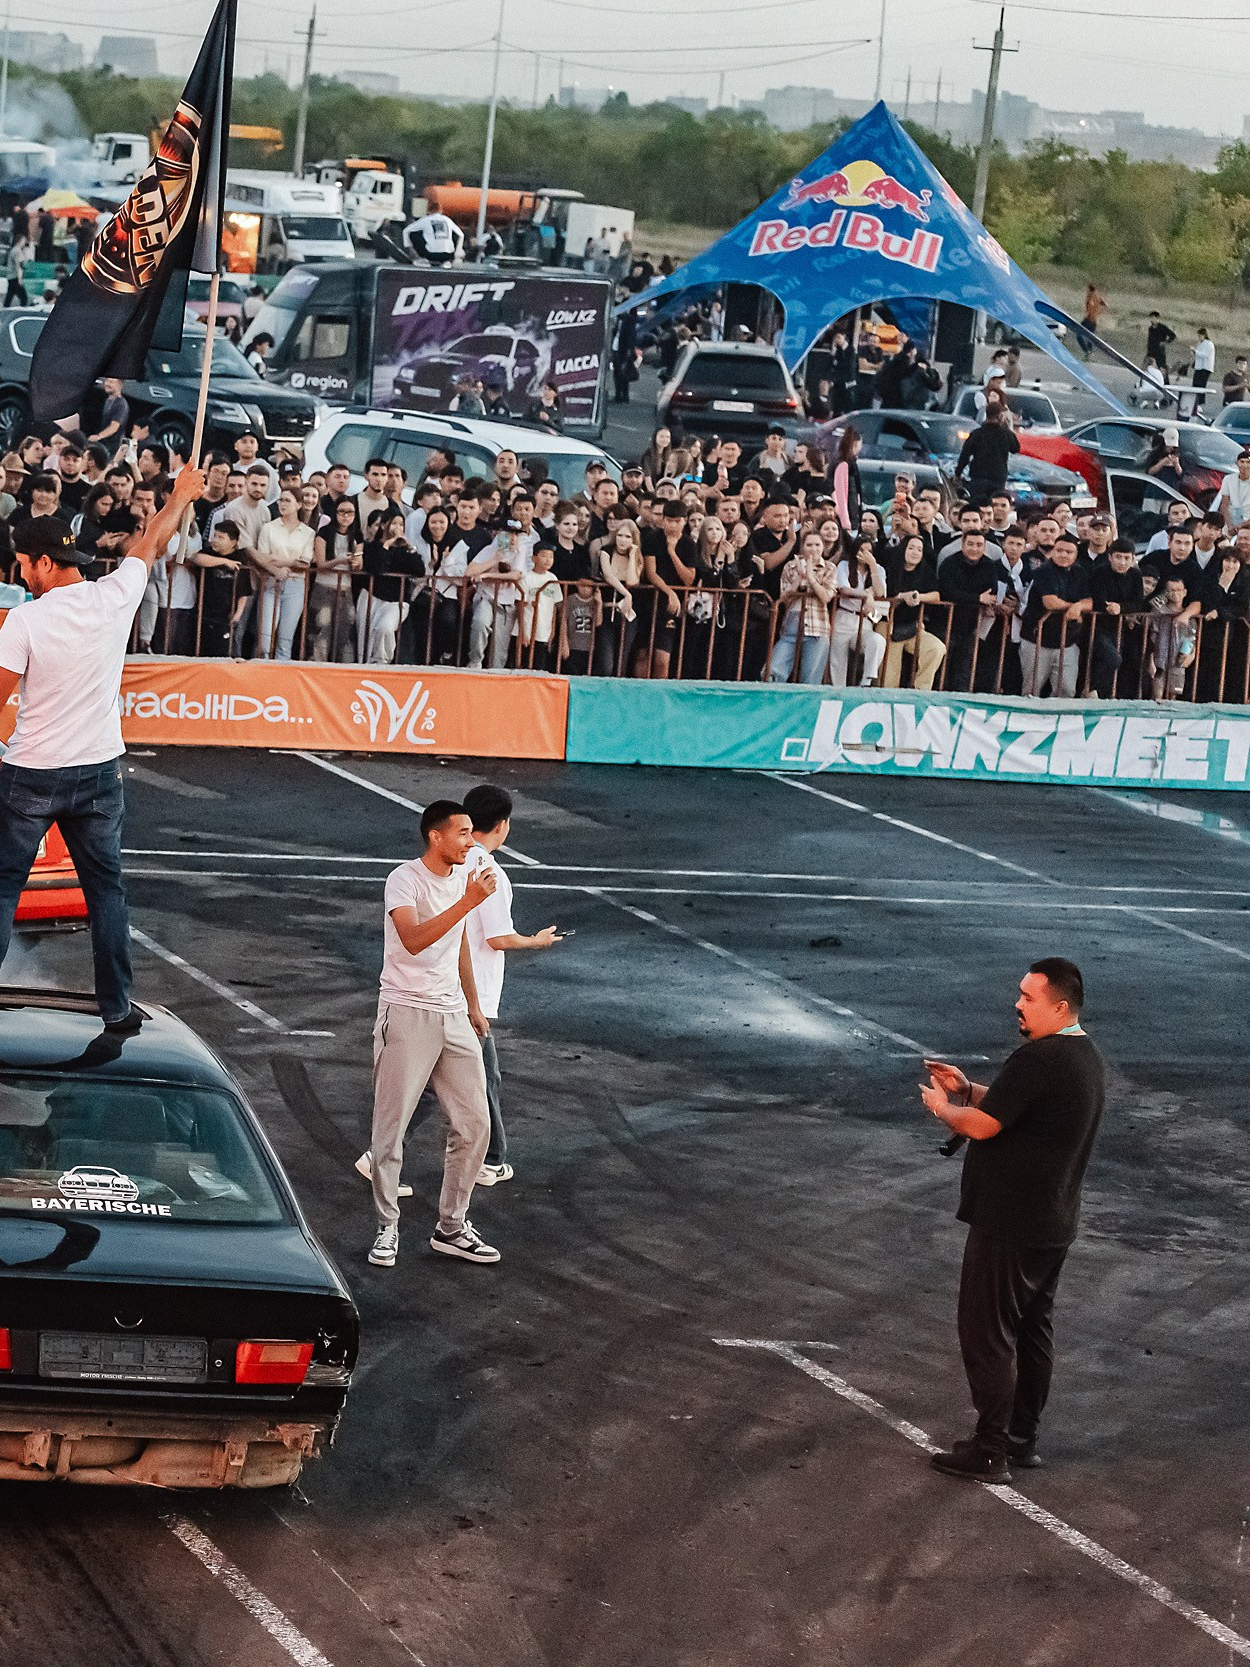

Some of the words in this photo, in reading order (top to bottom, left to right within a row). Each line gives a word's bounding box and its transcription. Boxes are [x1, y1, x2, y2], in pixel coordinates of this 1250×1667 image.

[749, 209, 847, 256] Red
[842, 211, 943, 273] Bull
[391, 281, 516, 317] DRIFT
[546, 310, 578, 325] LOW
[577, 309, 597, 323] KZ
[555, 354, 600, 375] КАССА
[306, 375, 348, 391] region
[807, 699, 1250, 782] LOWKZMEET
[31, 1198, 172, 1216] BAYERISCHE
